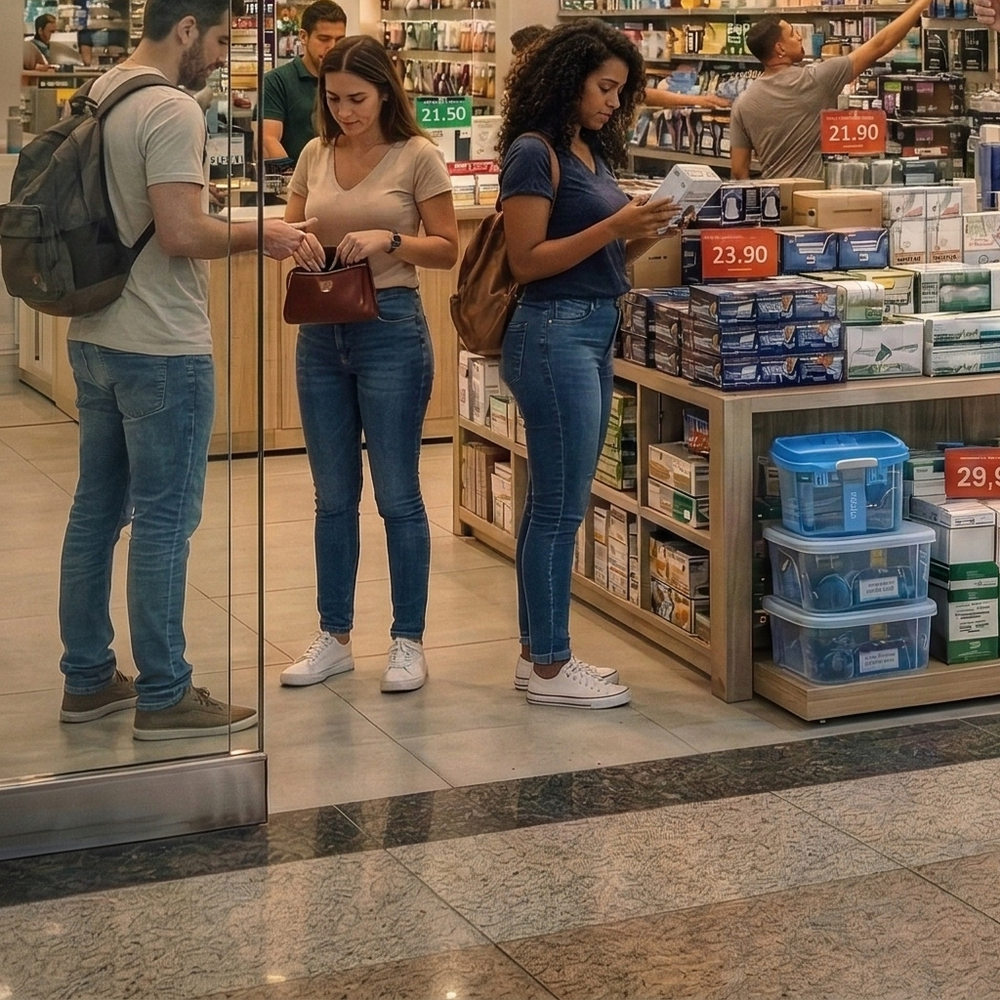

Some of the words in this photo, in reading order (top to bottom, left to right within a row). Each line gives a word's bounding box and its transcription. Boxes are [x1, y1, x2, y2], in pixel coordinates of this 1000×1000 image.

[421, 106, 466, 122] 21.50
[829, 123, 879, 142] 21.90
[712, 245, 768, 264] 23.90
